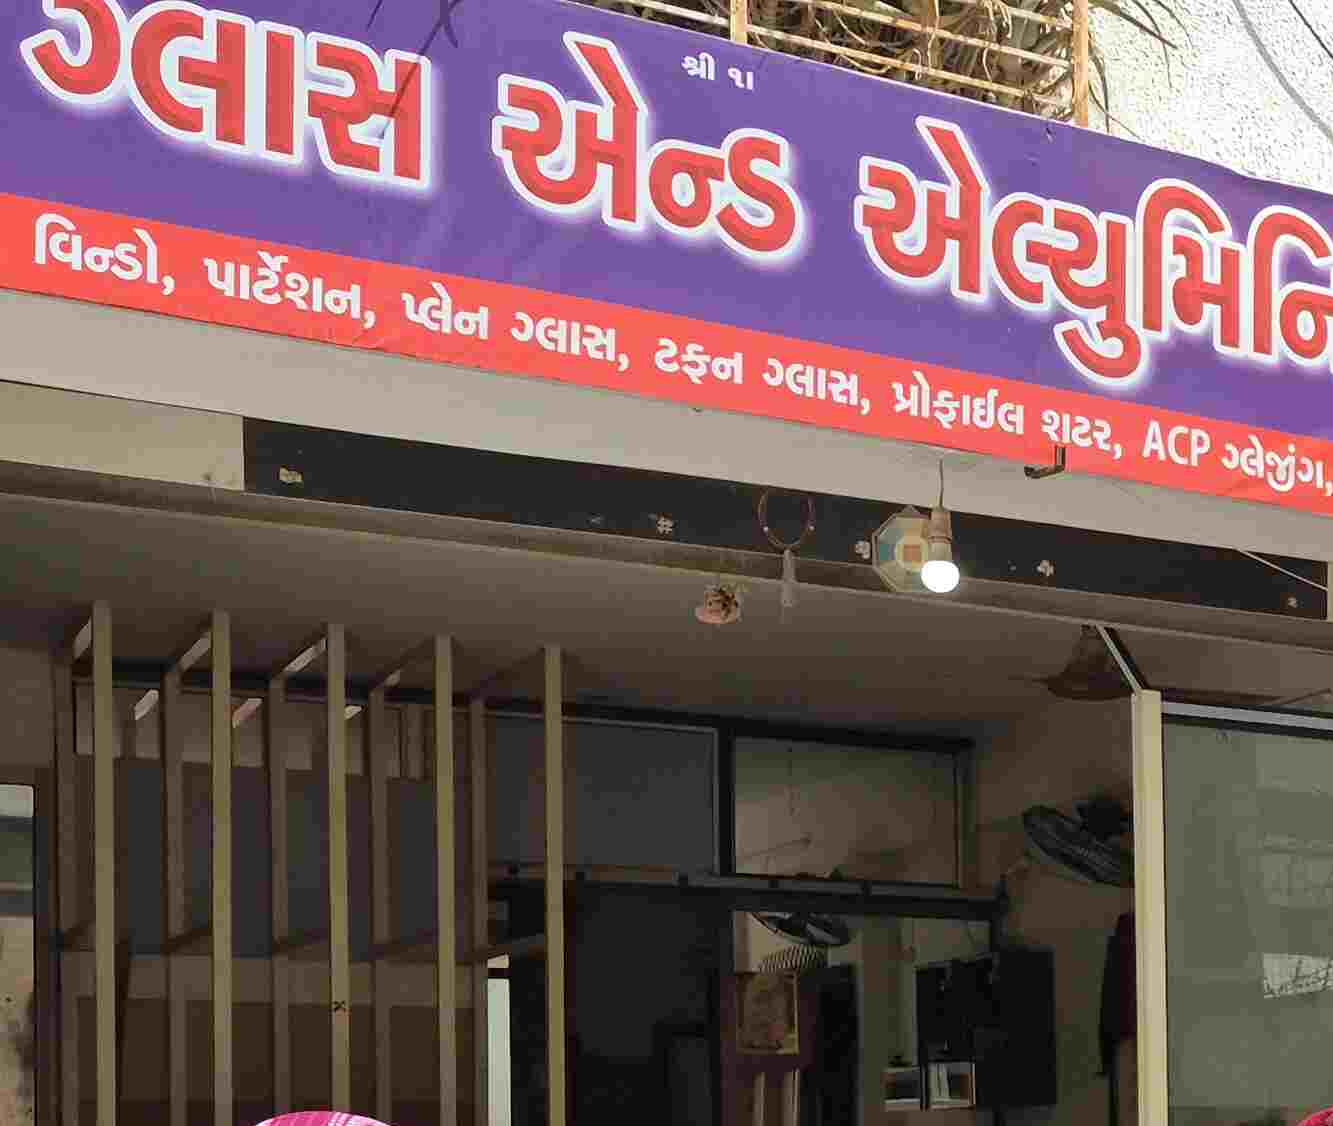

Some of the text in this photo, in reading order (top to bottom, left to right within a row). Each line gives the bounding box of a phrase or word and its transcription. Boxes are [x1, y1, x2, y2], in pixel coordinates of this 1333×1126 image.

[22, 0, 428, 185] ગ્લાસ
[493, 30, 800, 258] એન્ડ
[34, 213, 176, 296] વિન્ડો,
[401, 282, 490, 340] પ્લેન
[511, 312, 630, 372] ગ્લાસ,
[654, 338, 743, 385] ટફન
[762, 357, 871, 415] ગ્લાસ,
[1040, 409, 1124, 460] શટર,
[1142, 420, 1211, 467] ACP
